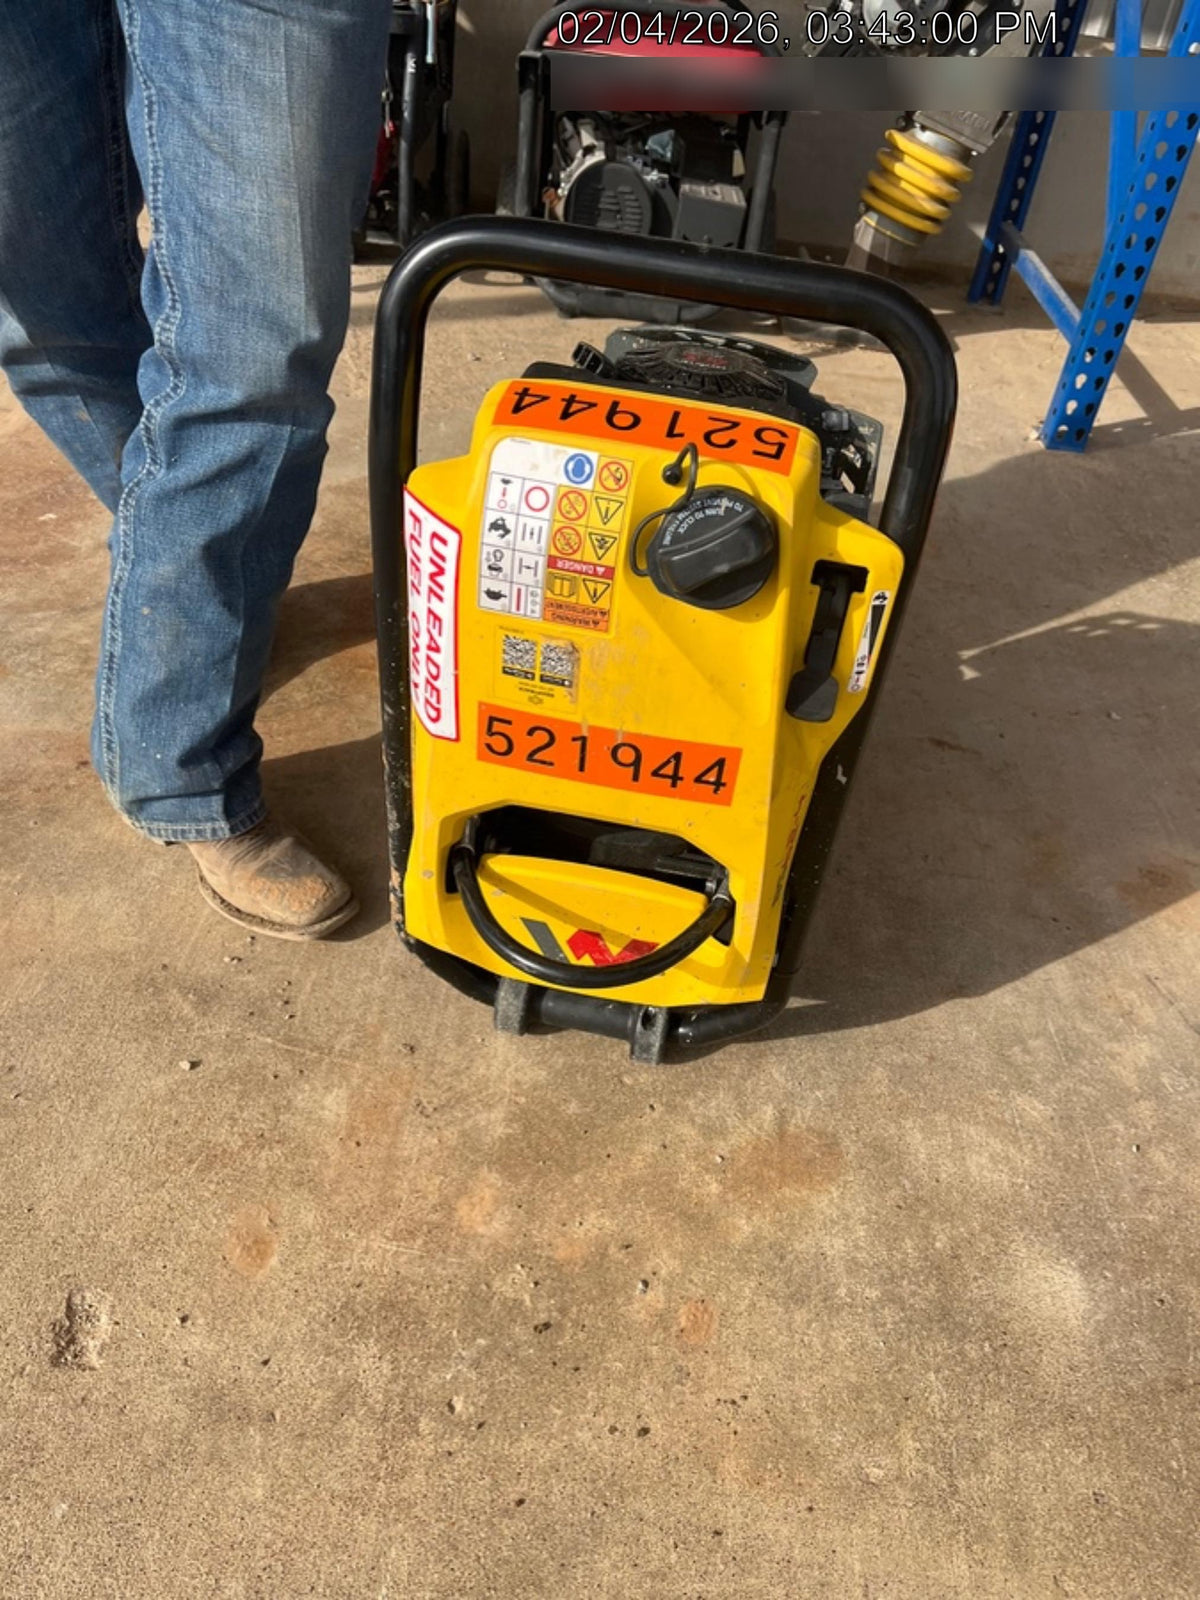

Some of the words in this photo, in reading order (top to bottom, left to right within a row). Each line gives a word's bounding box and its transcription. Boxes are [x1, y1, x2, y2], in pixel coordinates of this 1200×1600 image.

[511, 386, 790, 461] 521944
[408, 508, 422, 598] FUEL
[424, 530, 449, 724] UNLEADED
[484, 715, 727, 795] 521944
